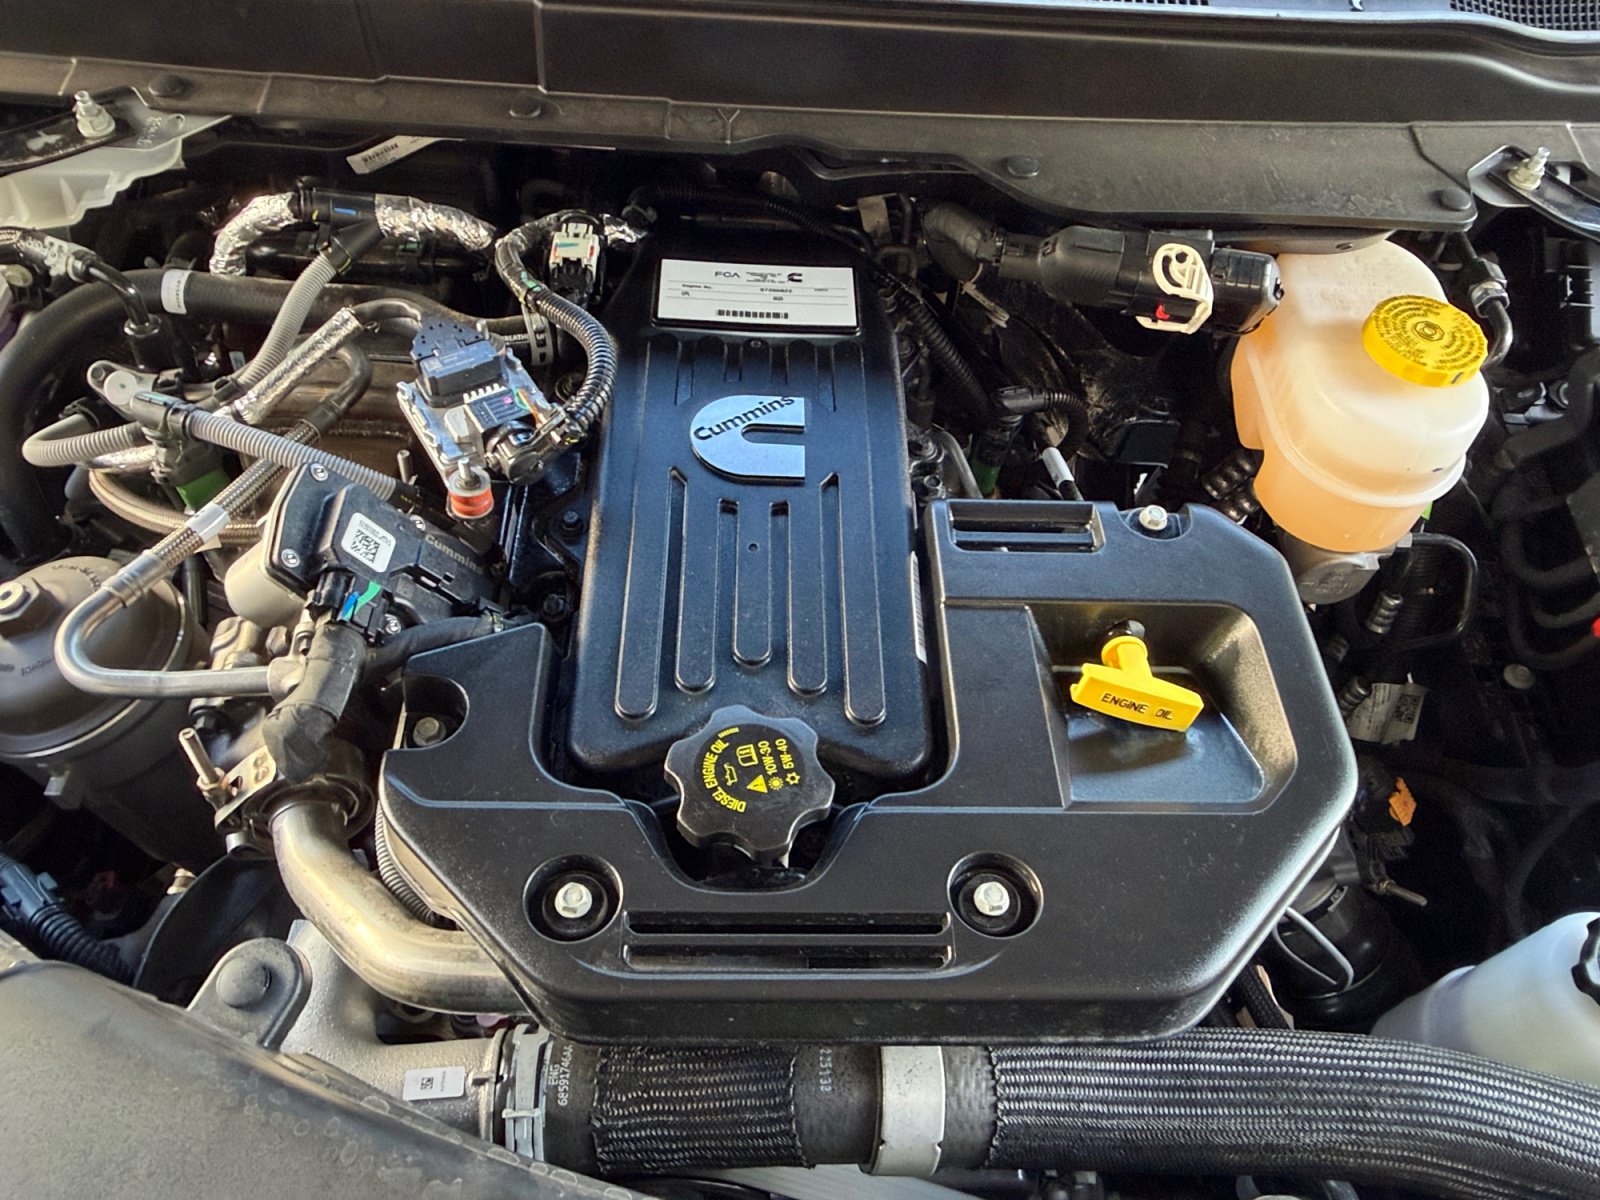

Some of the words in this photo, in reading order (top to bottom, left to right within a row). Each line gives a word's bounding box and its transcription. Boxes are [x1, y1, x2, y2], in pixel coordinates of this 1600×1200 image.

[714, 271, 740, 279] FCA
[693, 396, 795, 441] Cummins
[425, 533, 483, 575] Cummins
[1101, 692, 1150, 714] ENGINE
[1155, 708, 1174, 721] OIL
[710, 739, 730, 754] OIL
[757, 740, 778, 776] 10W-30
[775, 738, 795, 770] 5W-40
[702, 751, 719, 790] ENGINE
[712, 786, 747, 813] DIESEL
